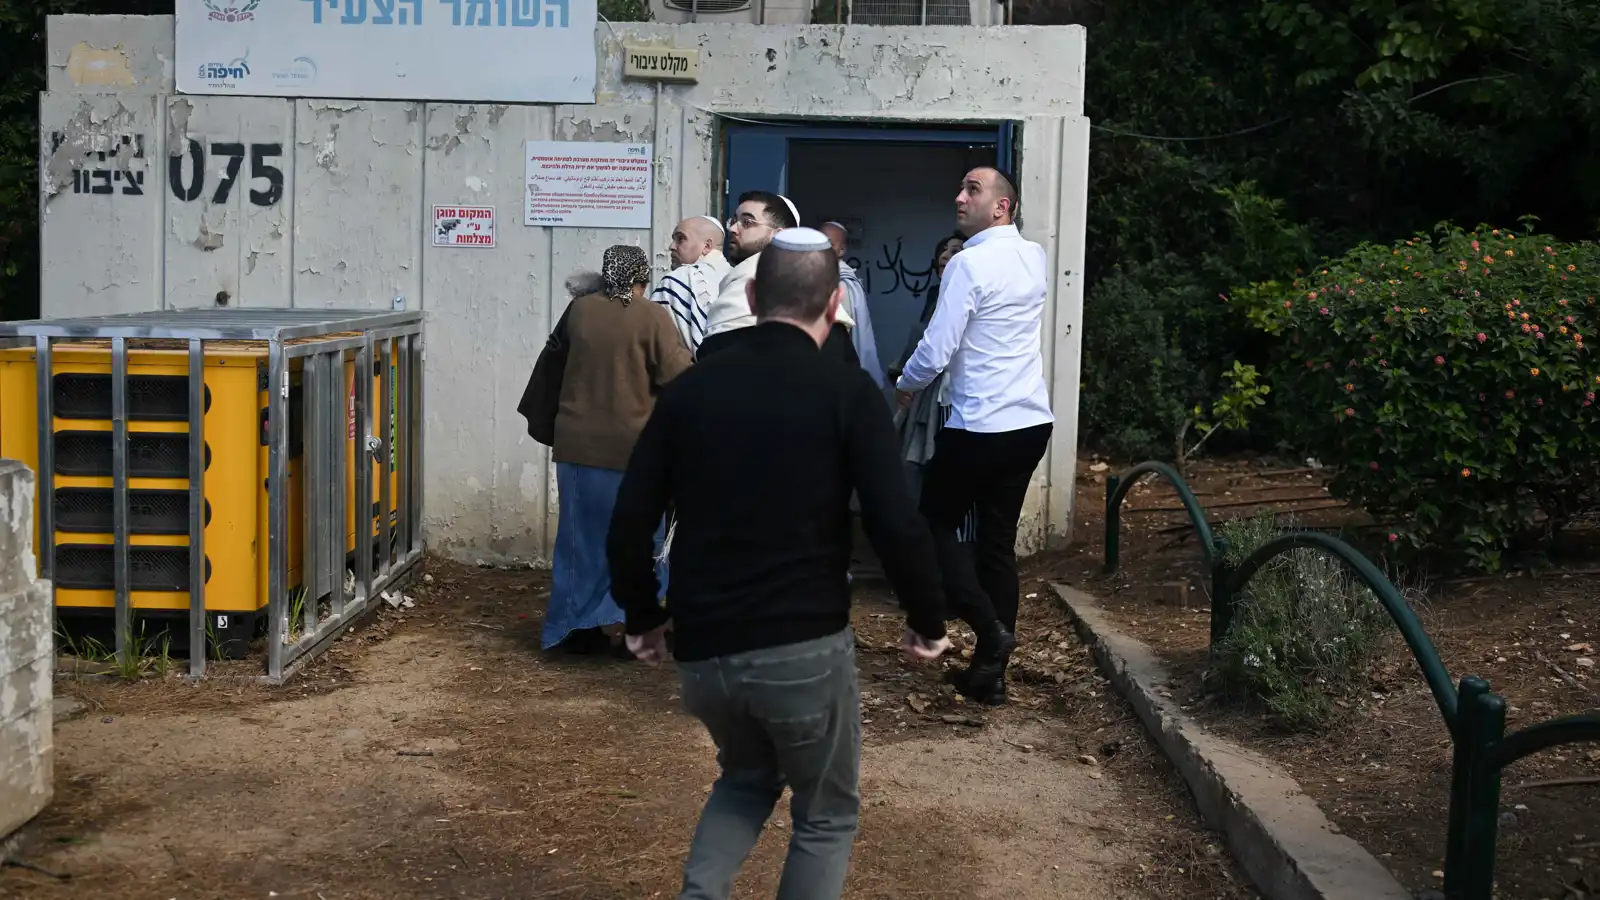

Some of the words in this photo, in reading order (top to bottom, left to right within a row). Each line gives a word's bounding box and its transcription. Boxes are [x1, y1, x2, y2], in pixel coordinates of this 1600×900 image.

[303, 0, 423, 26] הצעיר
[439, 0, 569, 28] השומר
[630, 54, 658, 70] ציבורי
[660, 52, 688, 75] מקלט
[207, 67, 244, 79] חיפה
[169, 139, 283, 206] 075
[436, 209, 456, 220] מוגן
[458, 209, 491, 220] המקום
[456, 232, 492, 244] מצלמות
